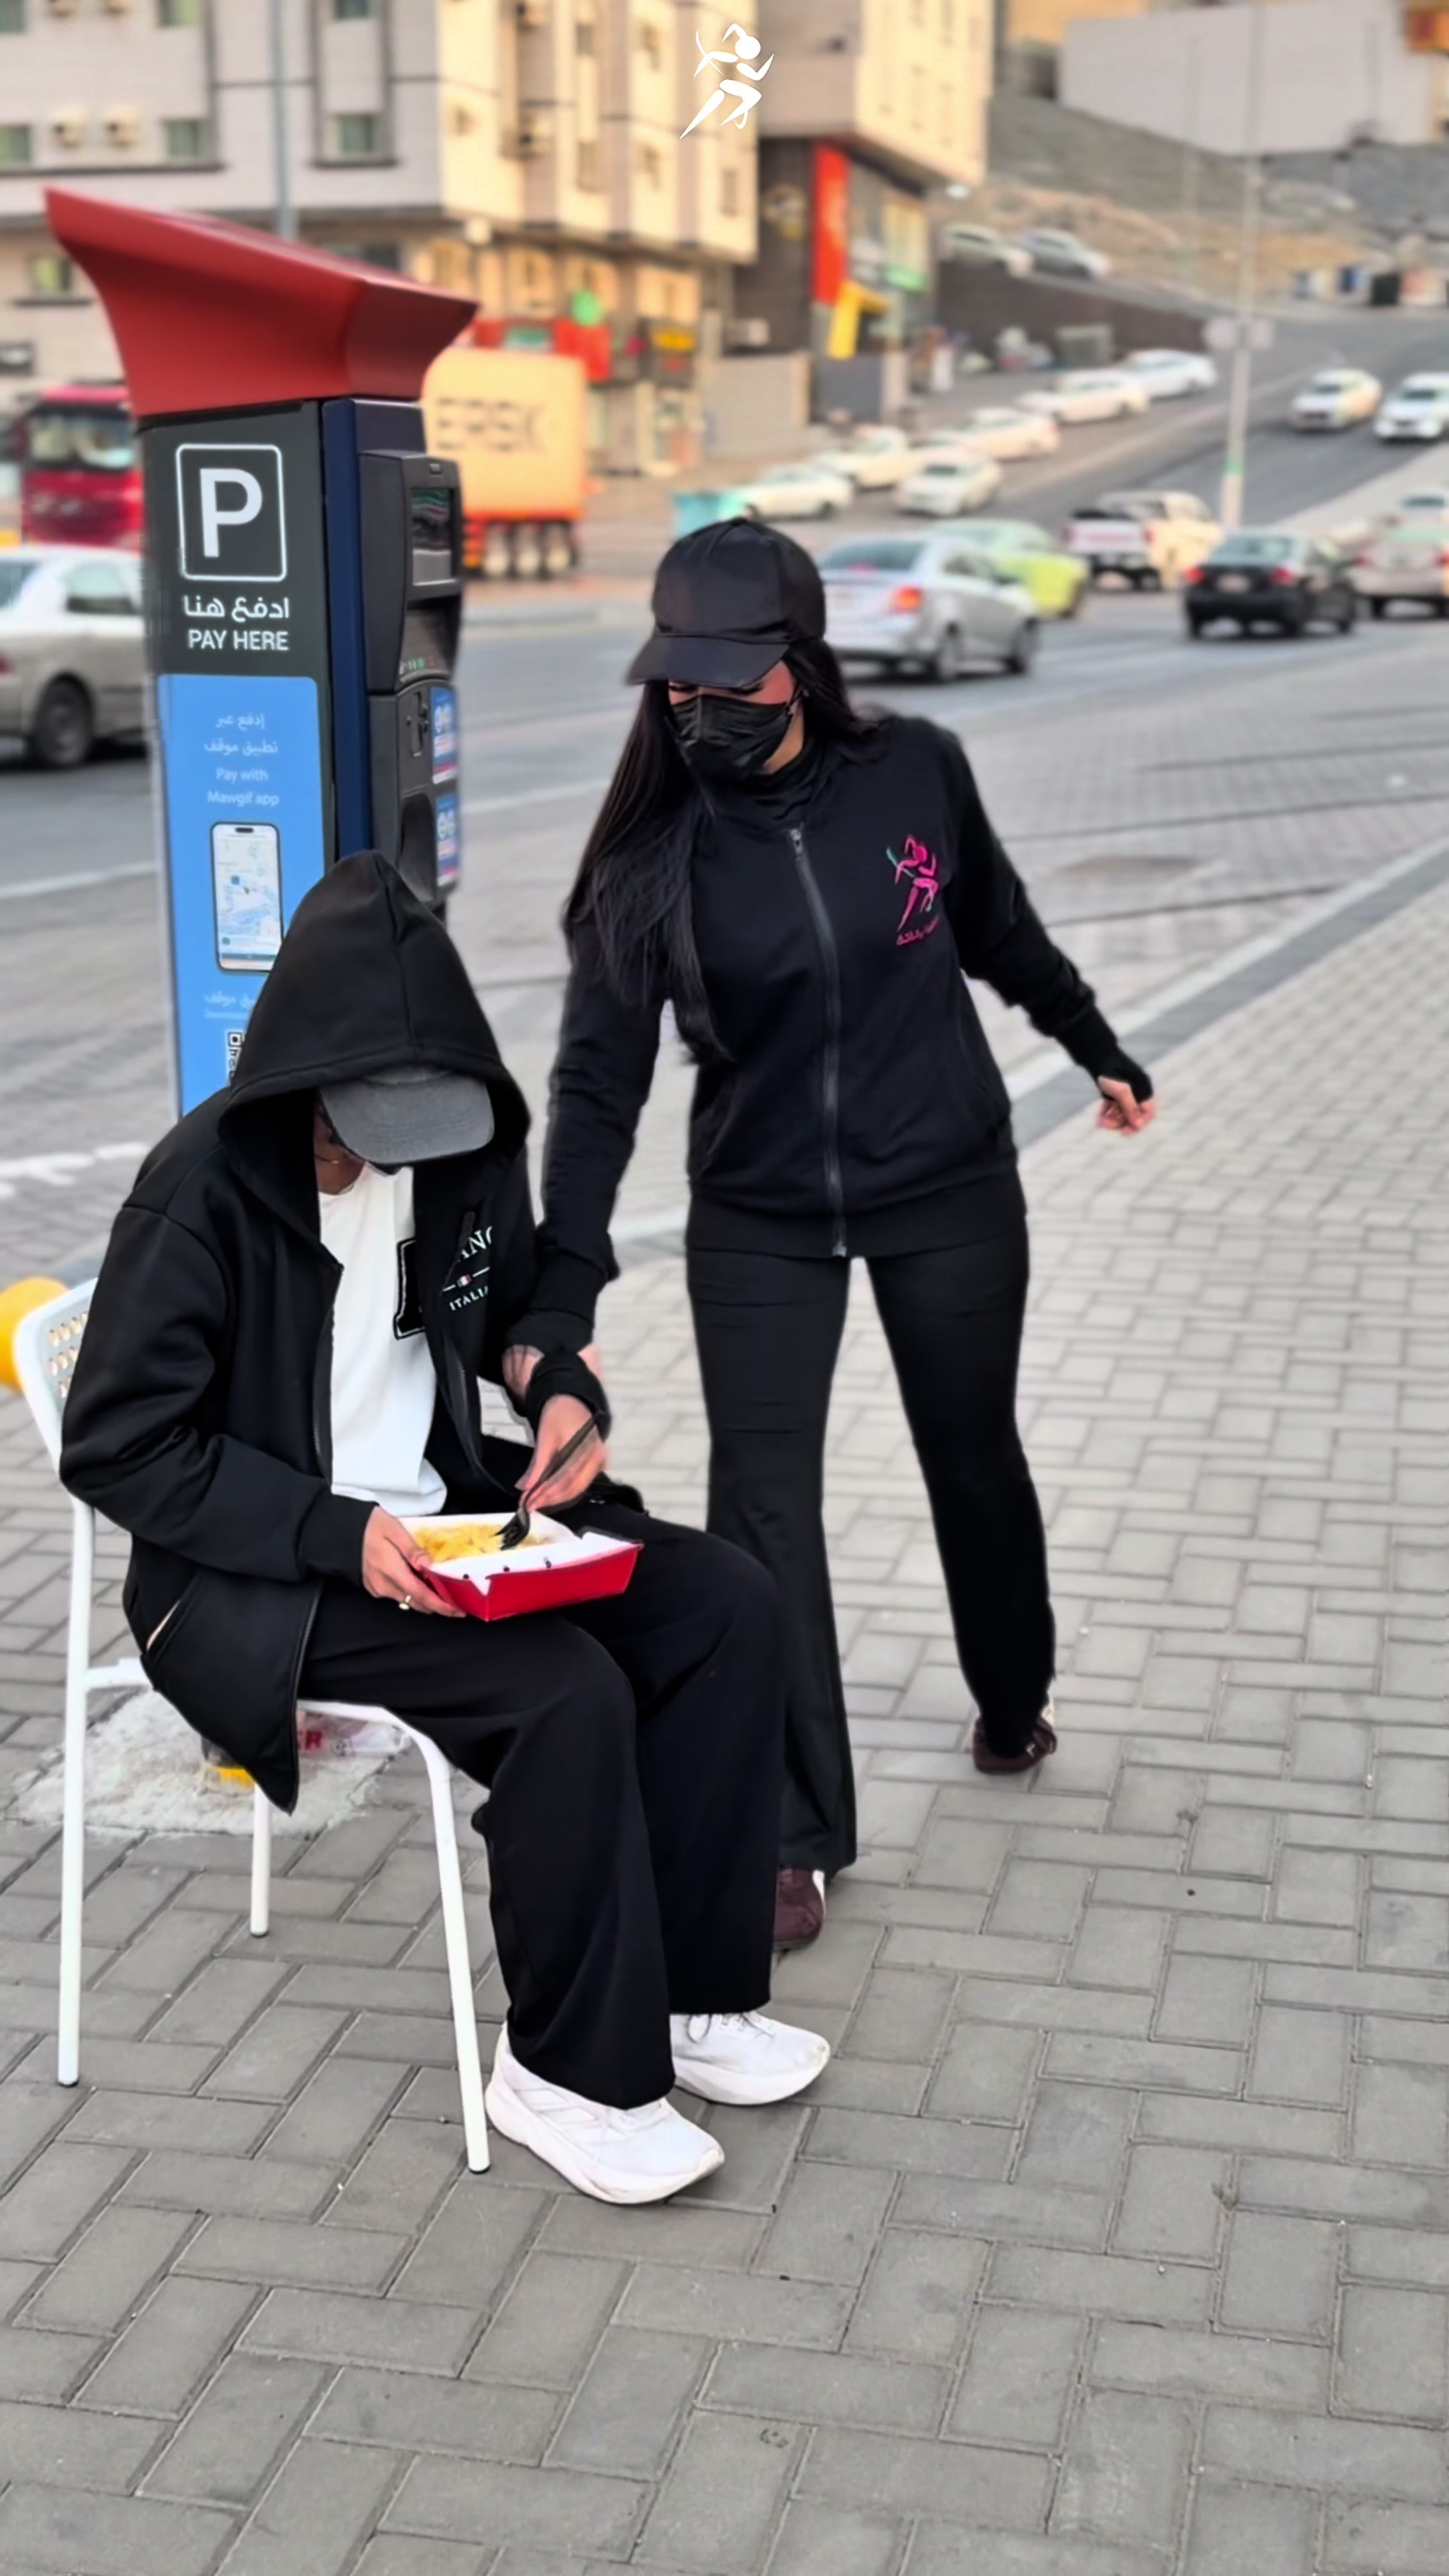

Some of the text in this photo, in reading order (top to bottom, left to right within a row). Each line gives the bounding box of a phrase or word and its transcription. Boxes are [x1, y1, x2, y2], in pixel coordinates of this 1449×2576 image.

[199, 468, 263, 558] P
[184, 594, 290, 623] ادفع هنا
[188, 629, 289, 651] PAY HERE
[242, 739, 279, 757] تطبيق
[215, 767, 268, 784] Pay with
[255, 794, 280, 807] app
